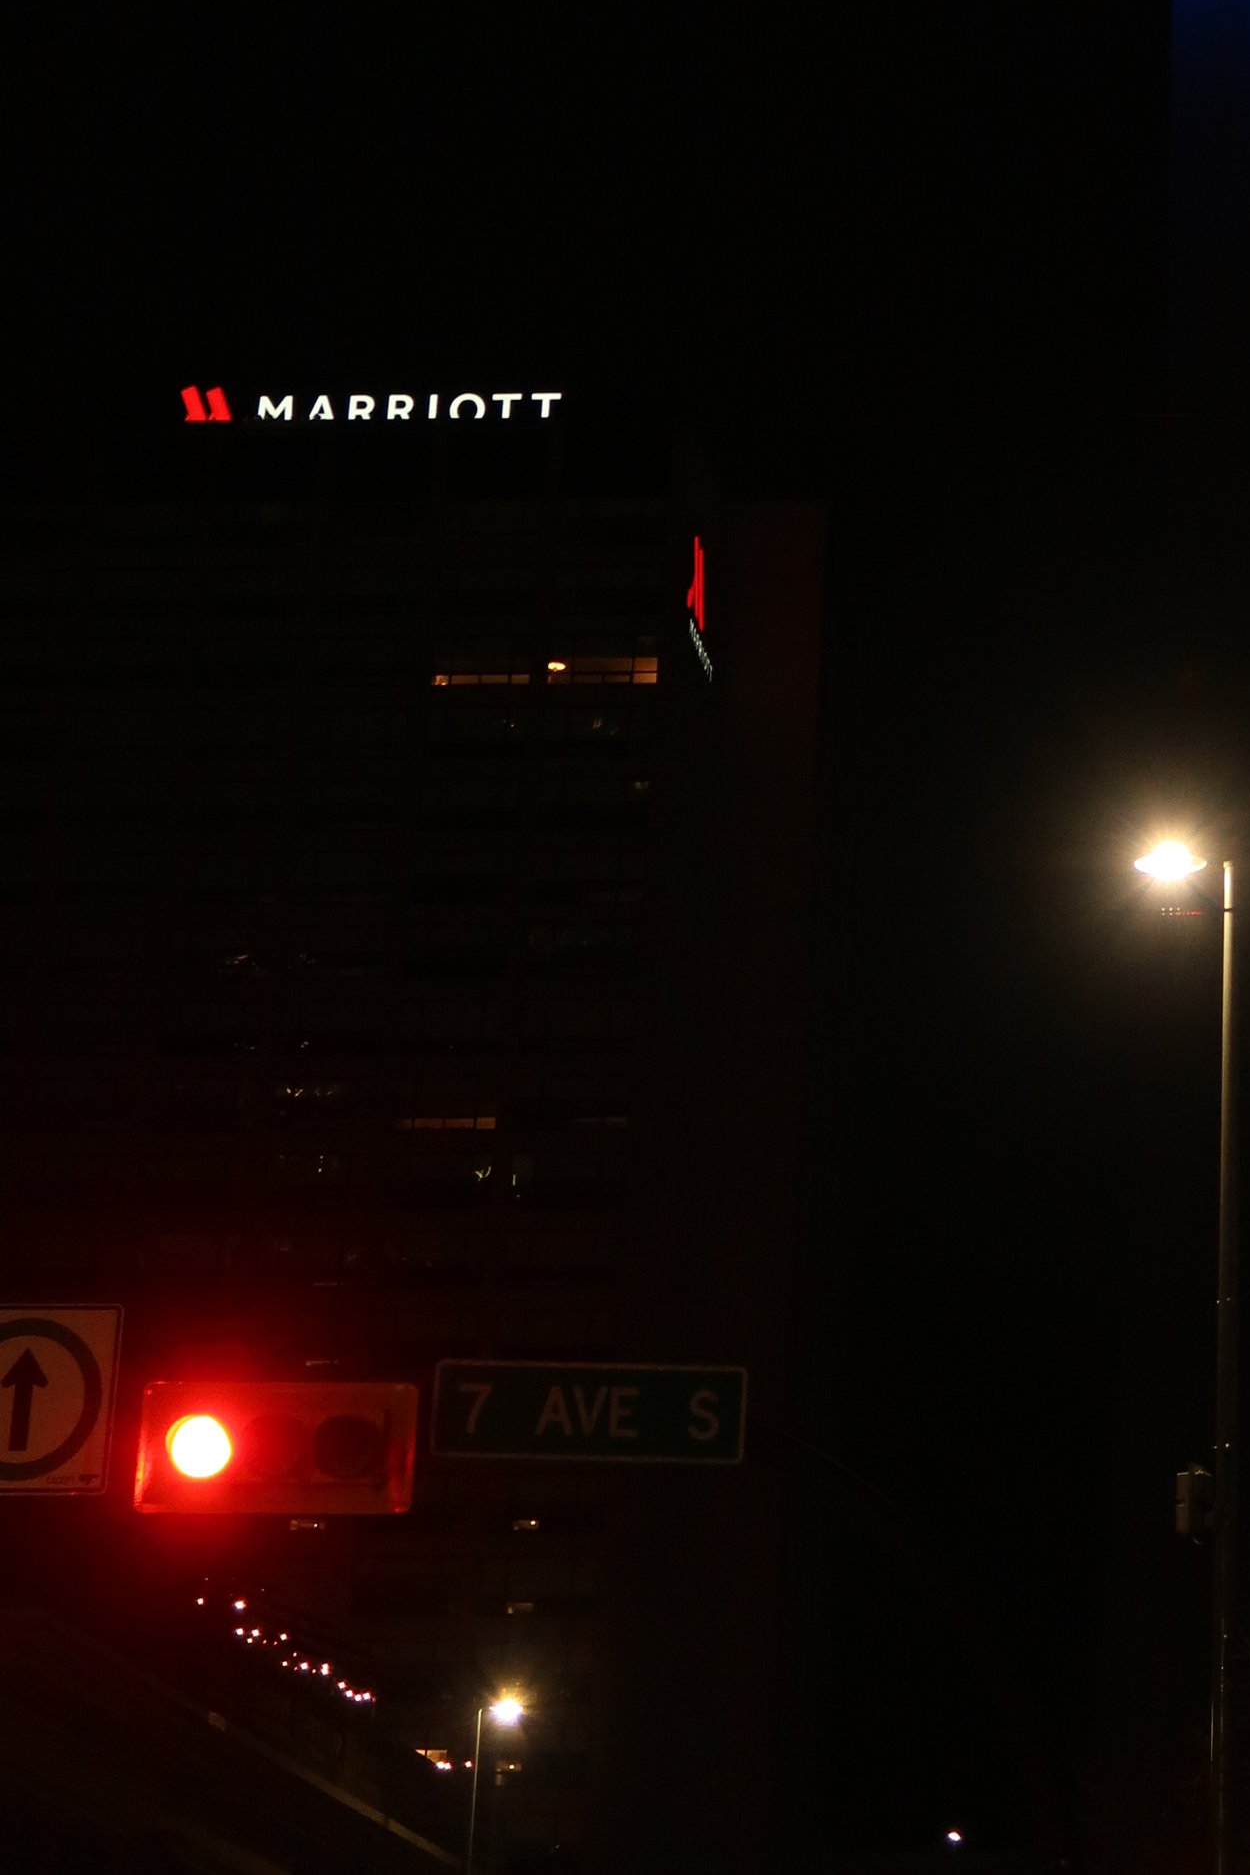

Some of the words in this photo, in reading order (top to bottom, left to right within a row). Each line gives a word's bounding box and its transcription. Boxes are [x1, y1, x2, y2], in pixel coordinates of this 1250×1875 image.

[256, 392, 562, 421] MARRIOTT
[458, 1382, 494, 1436] 7
[534, 1383, 640, 1439] AVE
[686, 1388, 721, 1442] S
